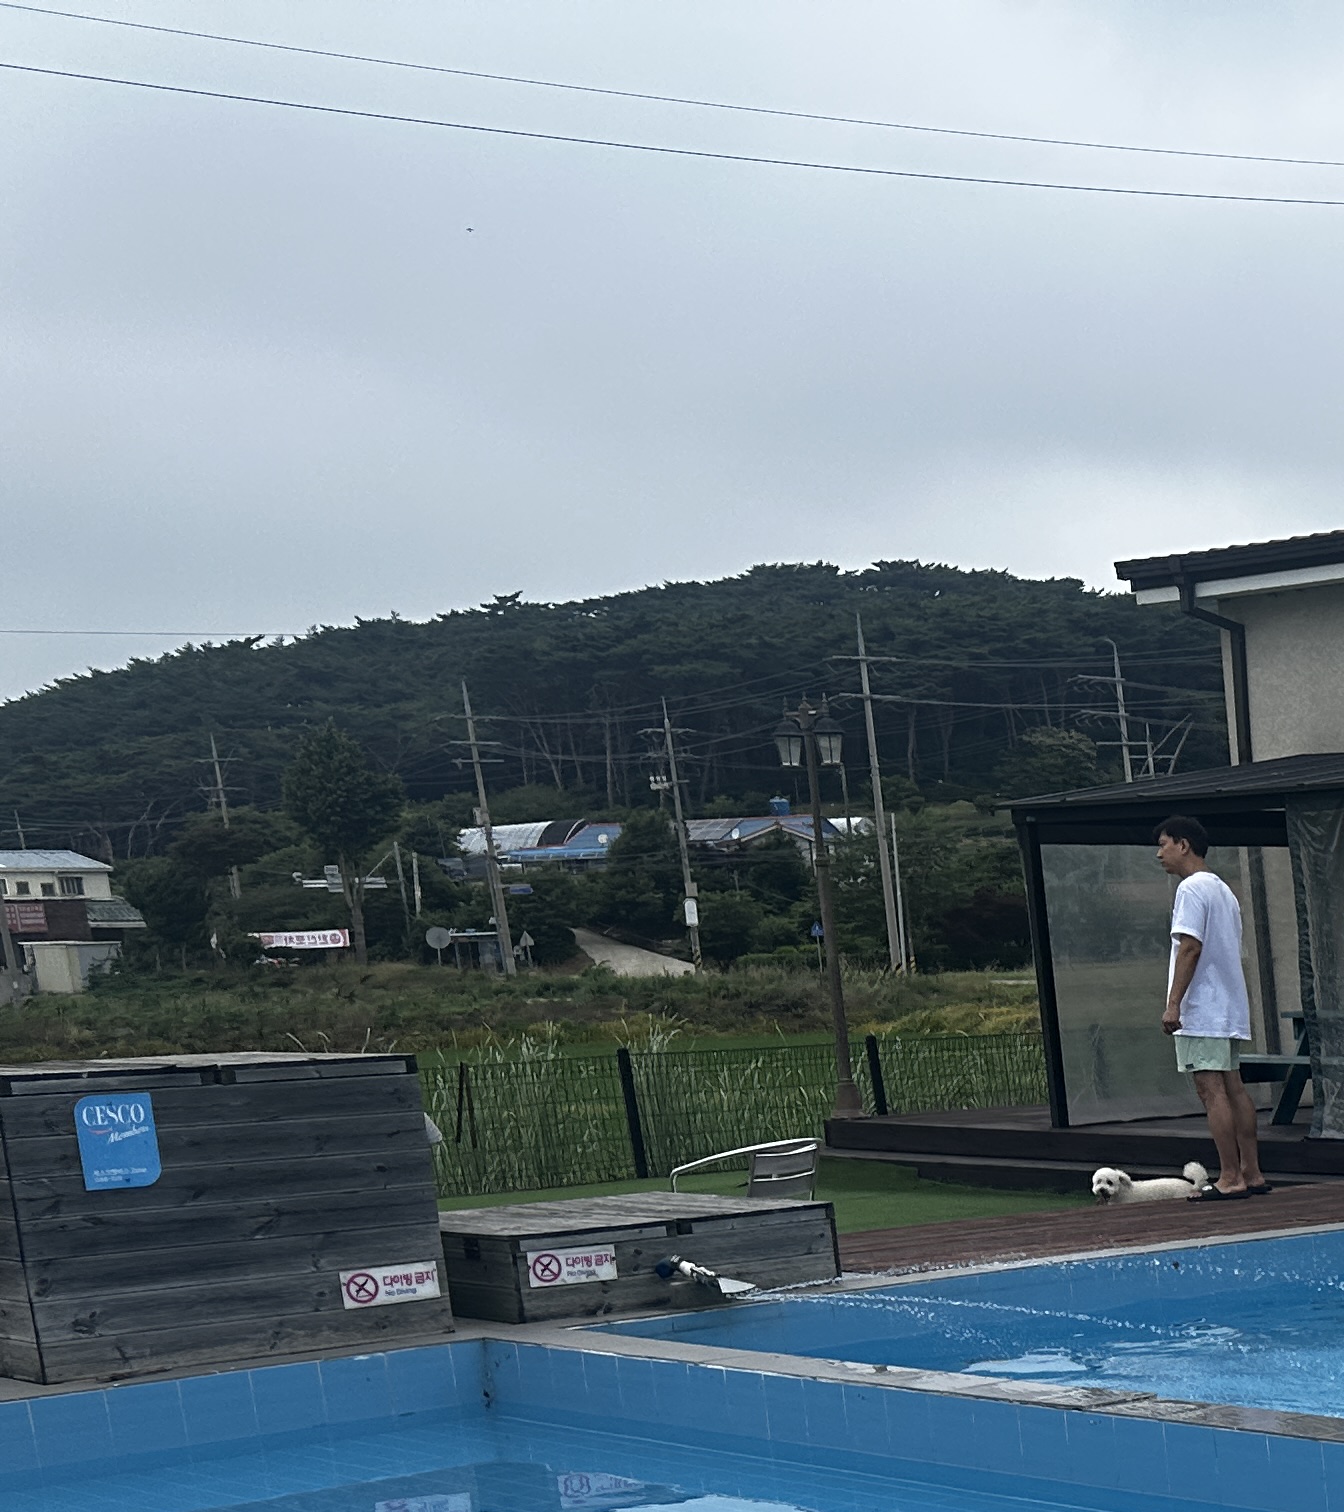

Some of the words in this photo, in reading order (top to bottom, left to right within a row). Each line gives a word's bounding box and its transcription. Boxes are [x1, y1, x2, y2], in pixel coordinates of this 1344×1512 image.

[82, 1103, 145, 1126] CESCO
[565, 1255, 593, 1268] 다이빙
[594, 1253, 613, 1266] 금지
[383, 1273, 412, 1287] 다이빙
[415, 1271, 435, 1284] 금지
